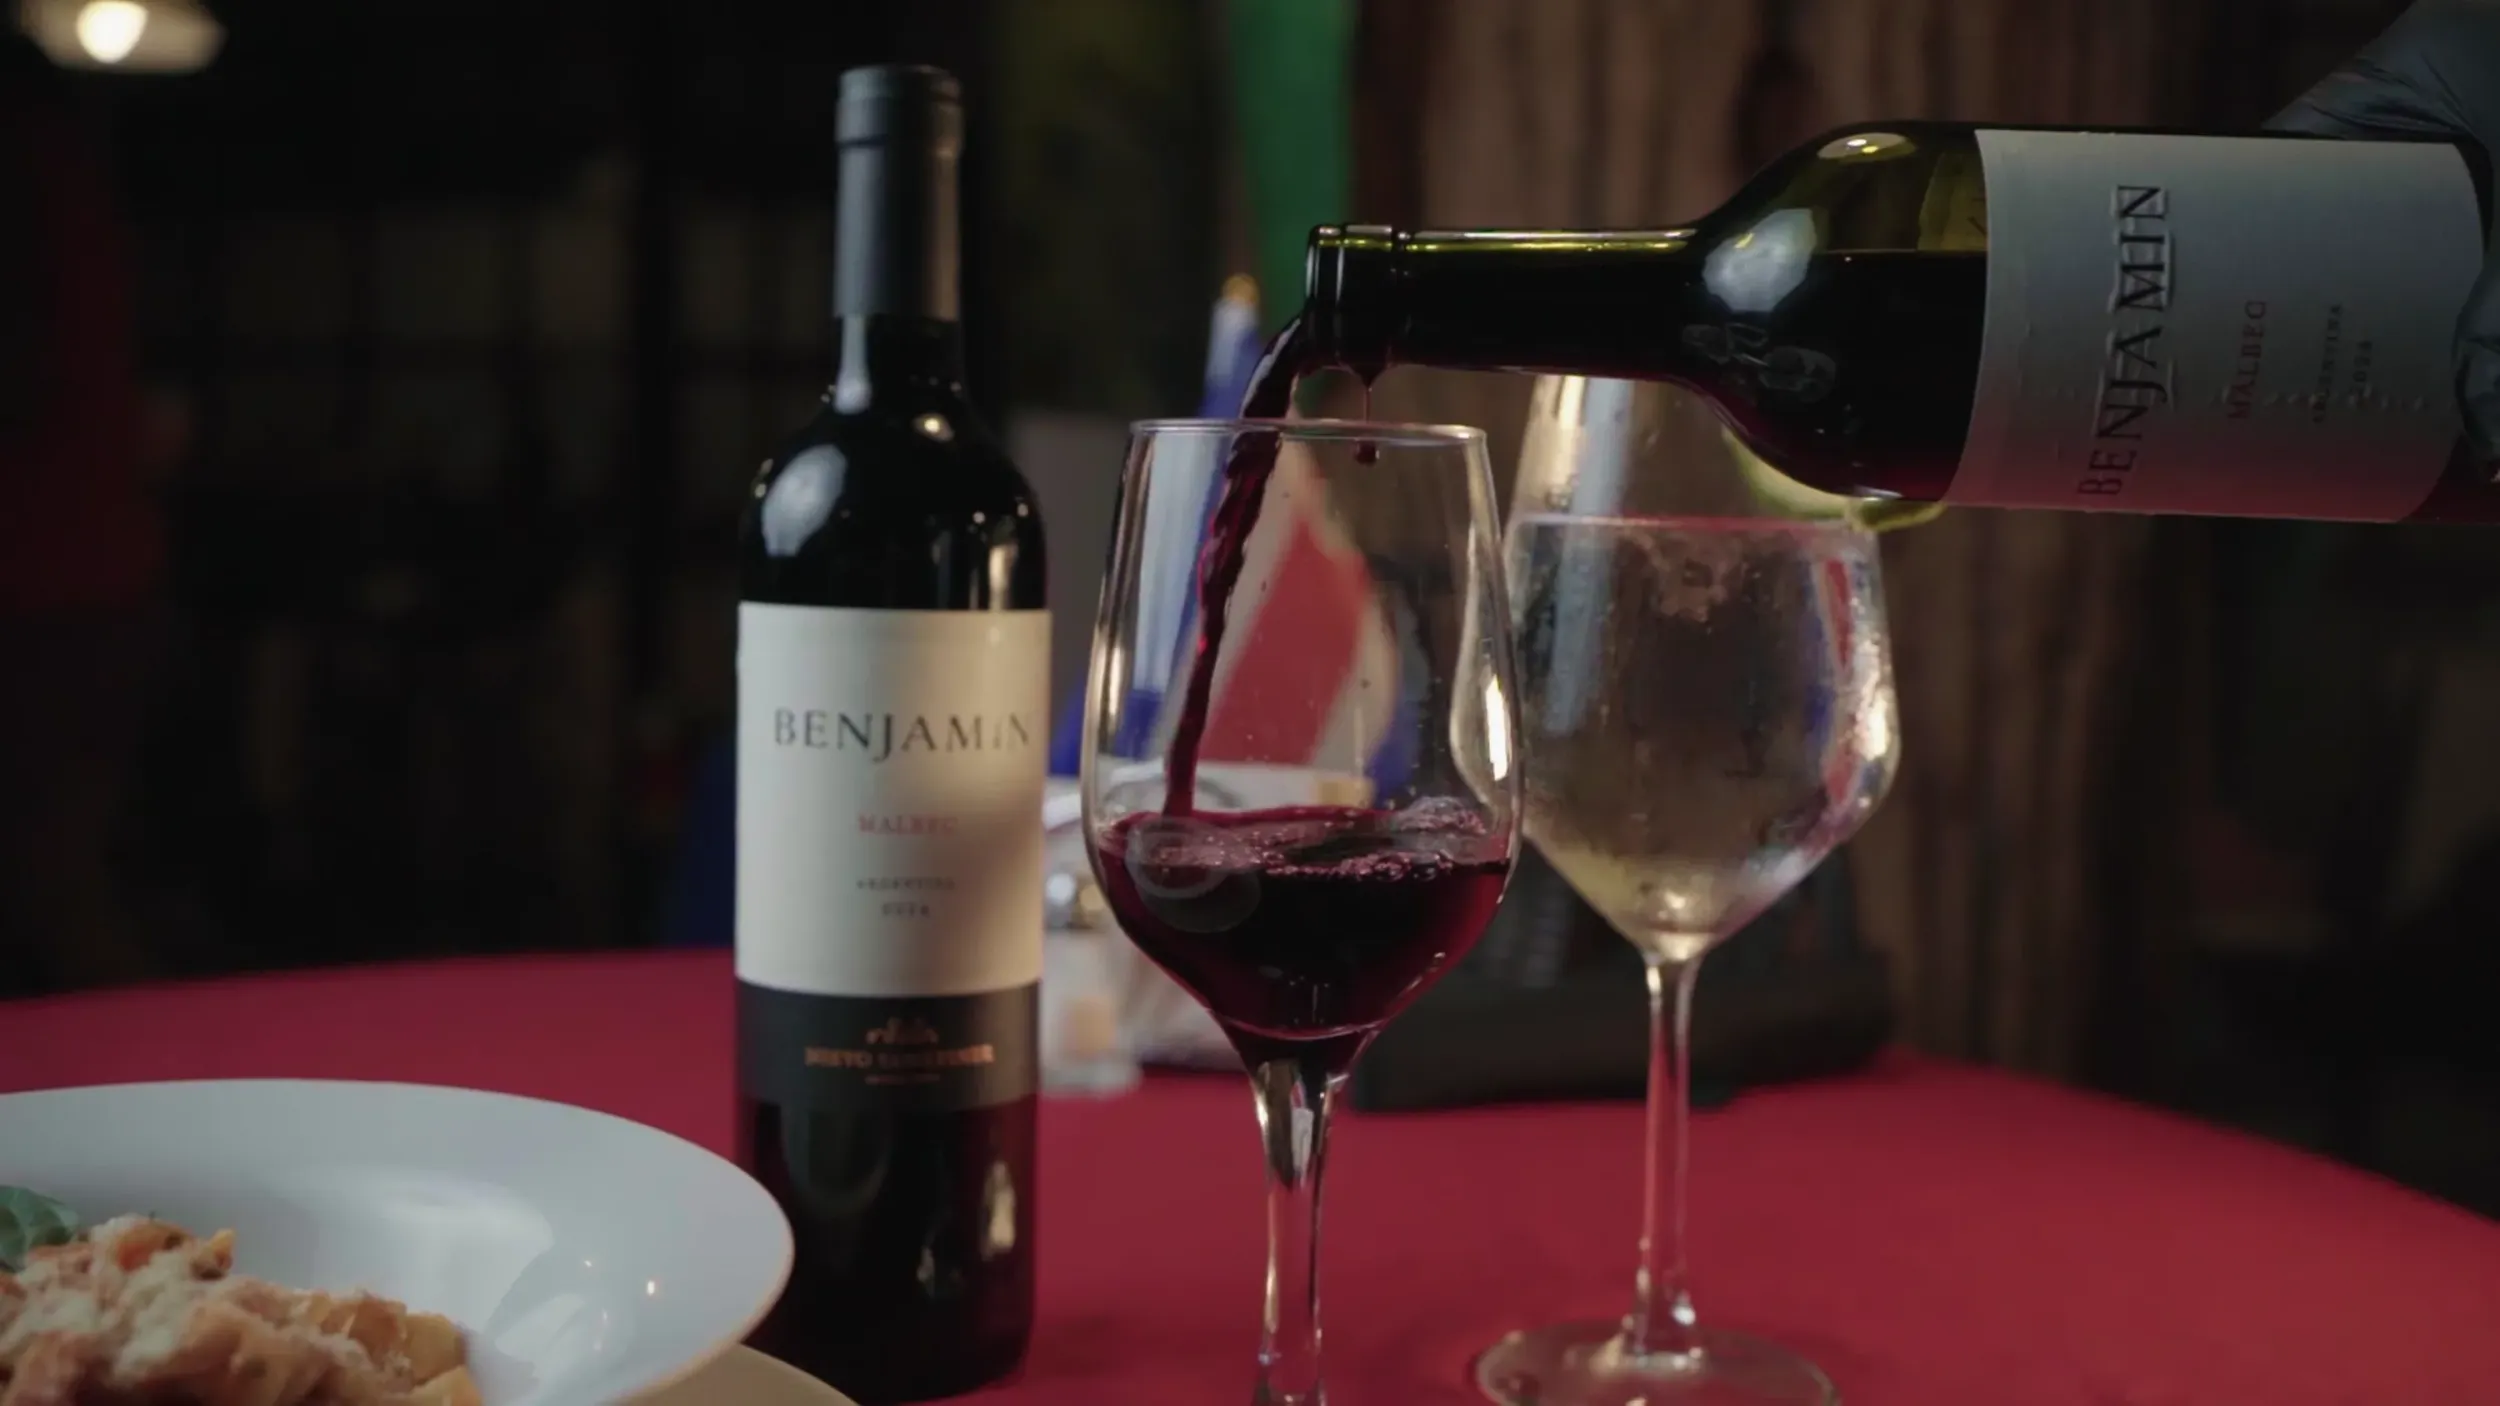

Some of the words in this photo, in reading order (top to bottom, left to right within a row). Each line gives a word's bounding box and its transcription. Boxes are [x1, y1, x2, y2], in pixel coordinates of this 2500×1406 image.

[2078, 184, 2168, 495] BENJAMIN
[2227, 300, 2267, 420] MALBEC
[774, 707, 1029, 763] BENJAMIN
